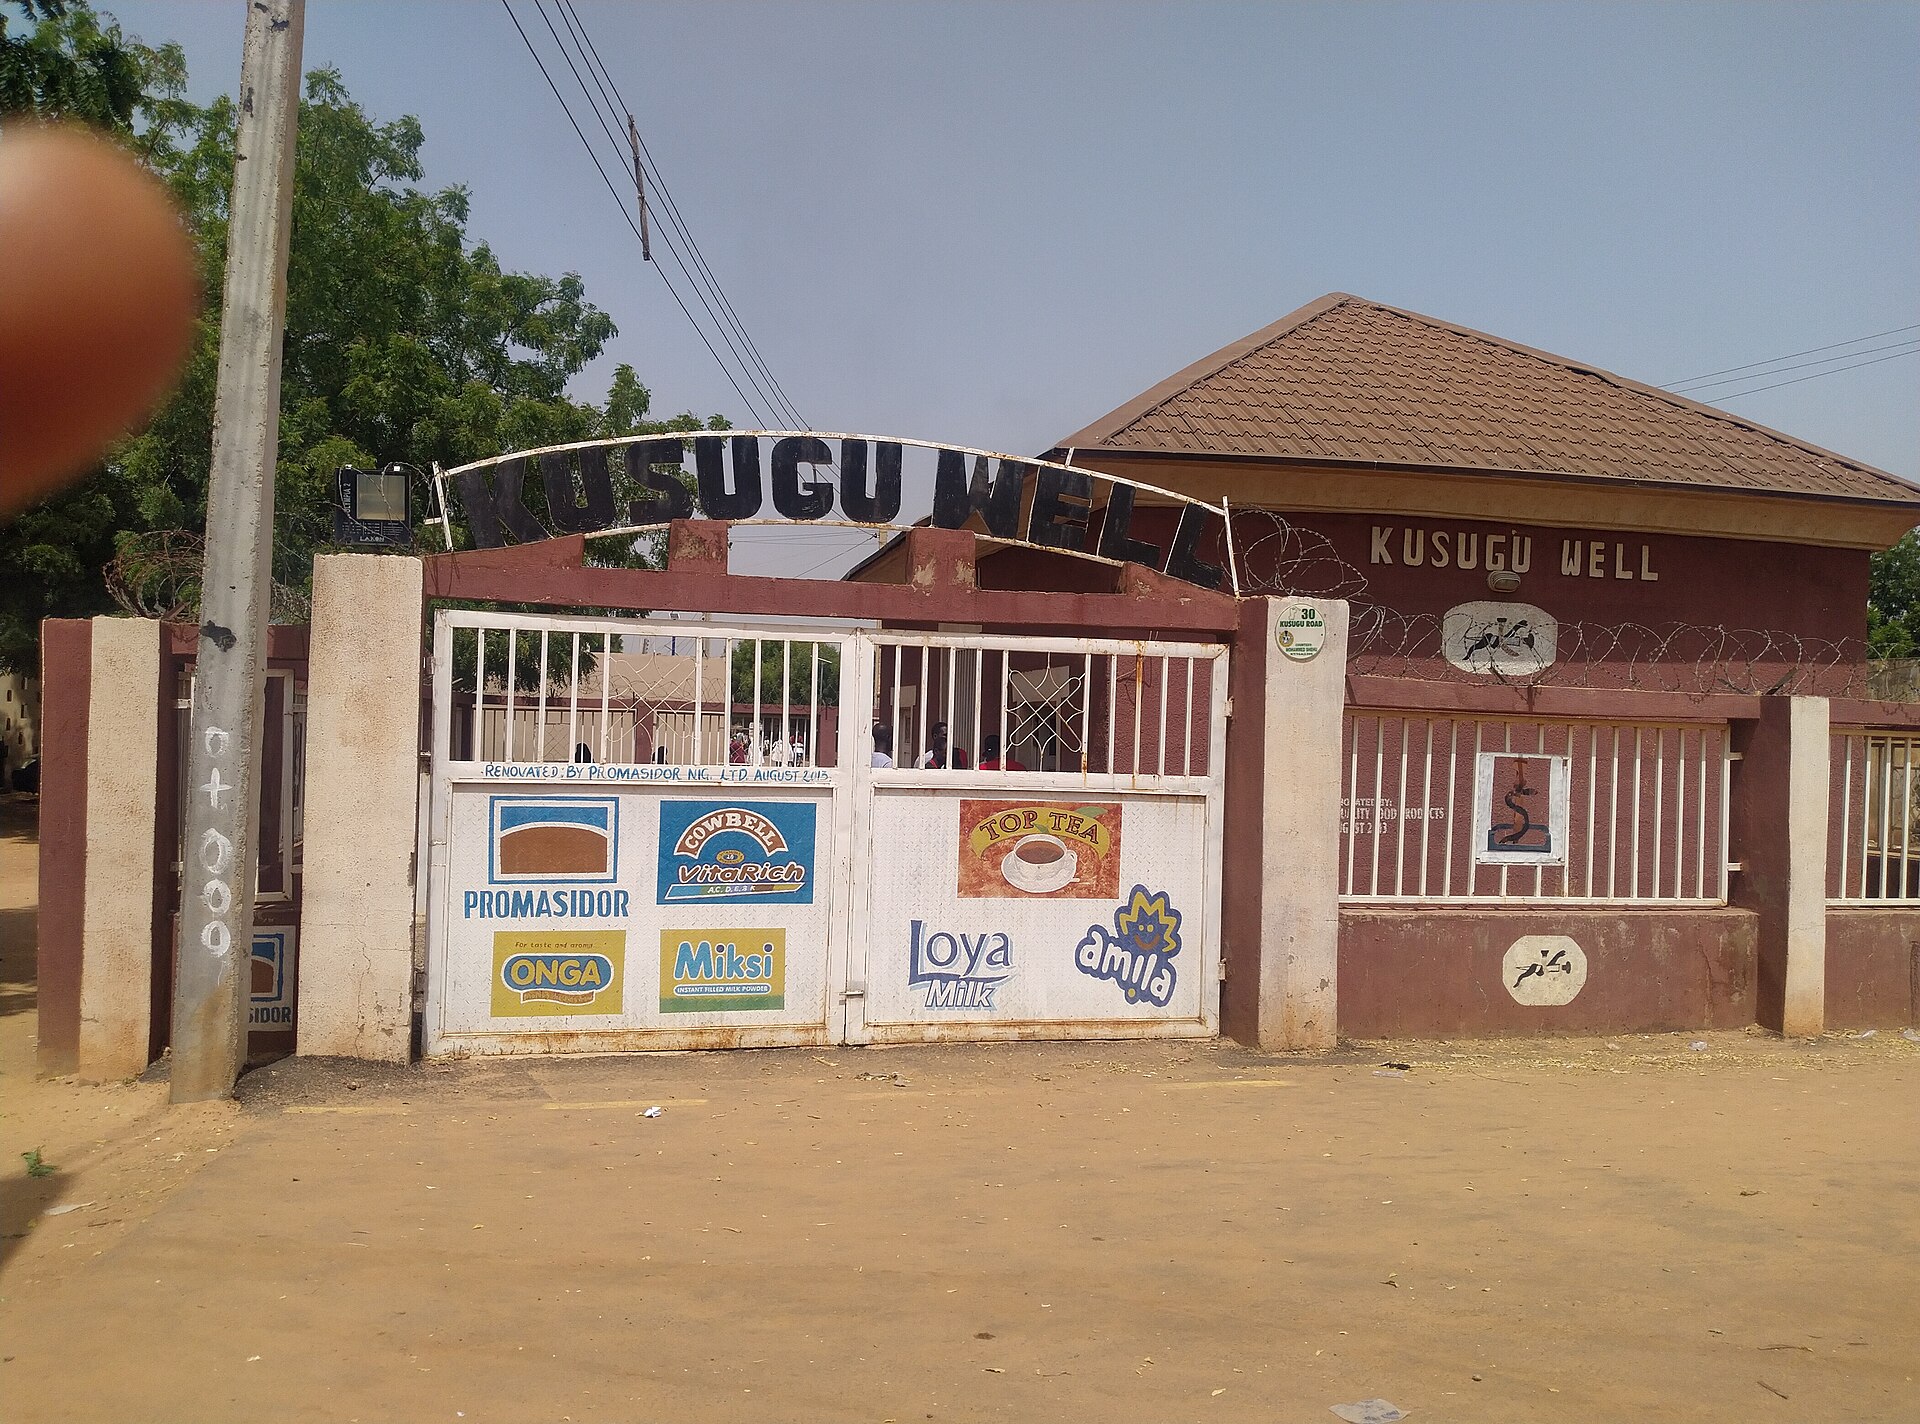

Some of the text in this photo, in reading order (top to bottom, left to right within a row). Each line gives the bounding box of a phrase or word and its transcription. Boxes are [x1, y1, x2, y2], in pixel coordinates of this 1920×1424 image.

[456, 436, 1224, 590] KUSUGU WELL
[1370, 526, 1659, 581] KUSUGU WELL
[1279, 620, 1323, 628] KUSUGU ROAD
[1301, 608, 1316, 620] 30
[566, 765, 585, 779] BY
[588, 765, 682, 781] PROMASIDOR
[753, 768, 800, 783] AUGUST
[979, 810, 1099, 844] TOP TEA
[1401, 807, 1445, 820] RODCTS
[684, 812, 777, 849] COWBELL
[679, 861, 805, 883] VitaRich
[463, 889, 630, 919] PROMASIDOR
[673, 940, 774, 981] Miksi
[908, 919, 1012, 986] Loya
[1078, 929, 1173, 1002] amila
[510, 958, 601, 986] ONGA
[924, 979, 997, 1009] Milk
